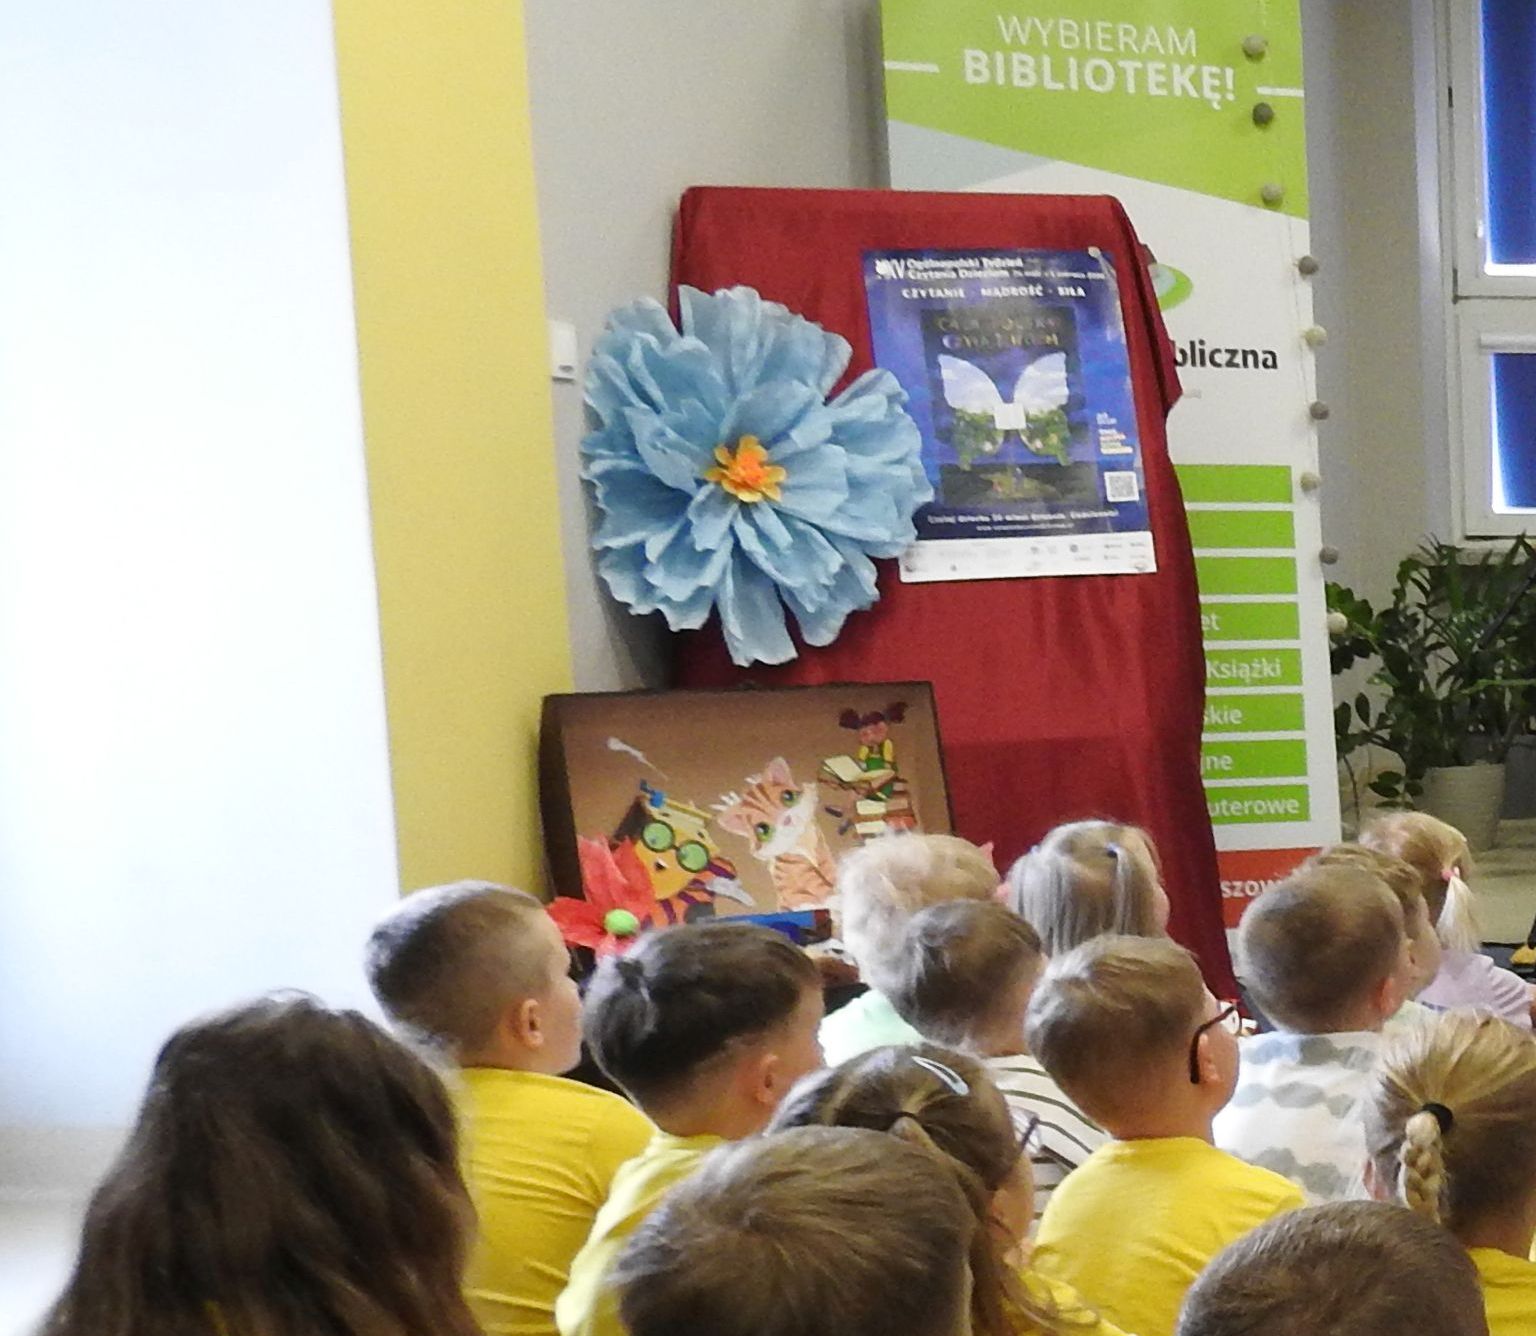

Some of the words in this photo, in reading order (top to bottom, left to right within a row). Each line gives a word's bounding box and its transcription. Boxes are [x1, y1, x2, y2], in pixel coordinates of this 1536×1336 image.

[997, 14, 1197, 57] WYBIERAM
[964, 49, 1235, 110] BIBLIOTEKĘ!
[1206, 656, 1282, 683] Książki
